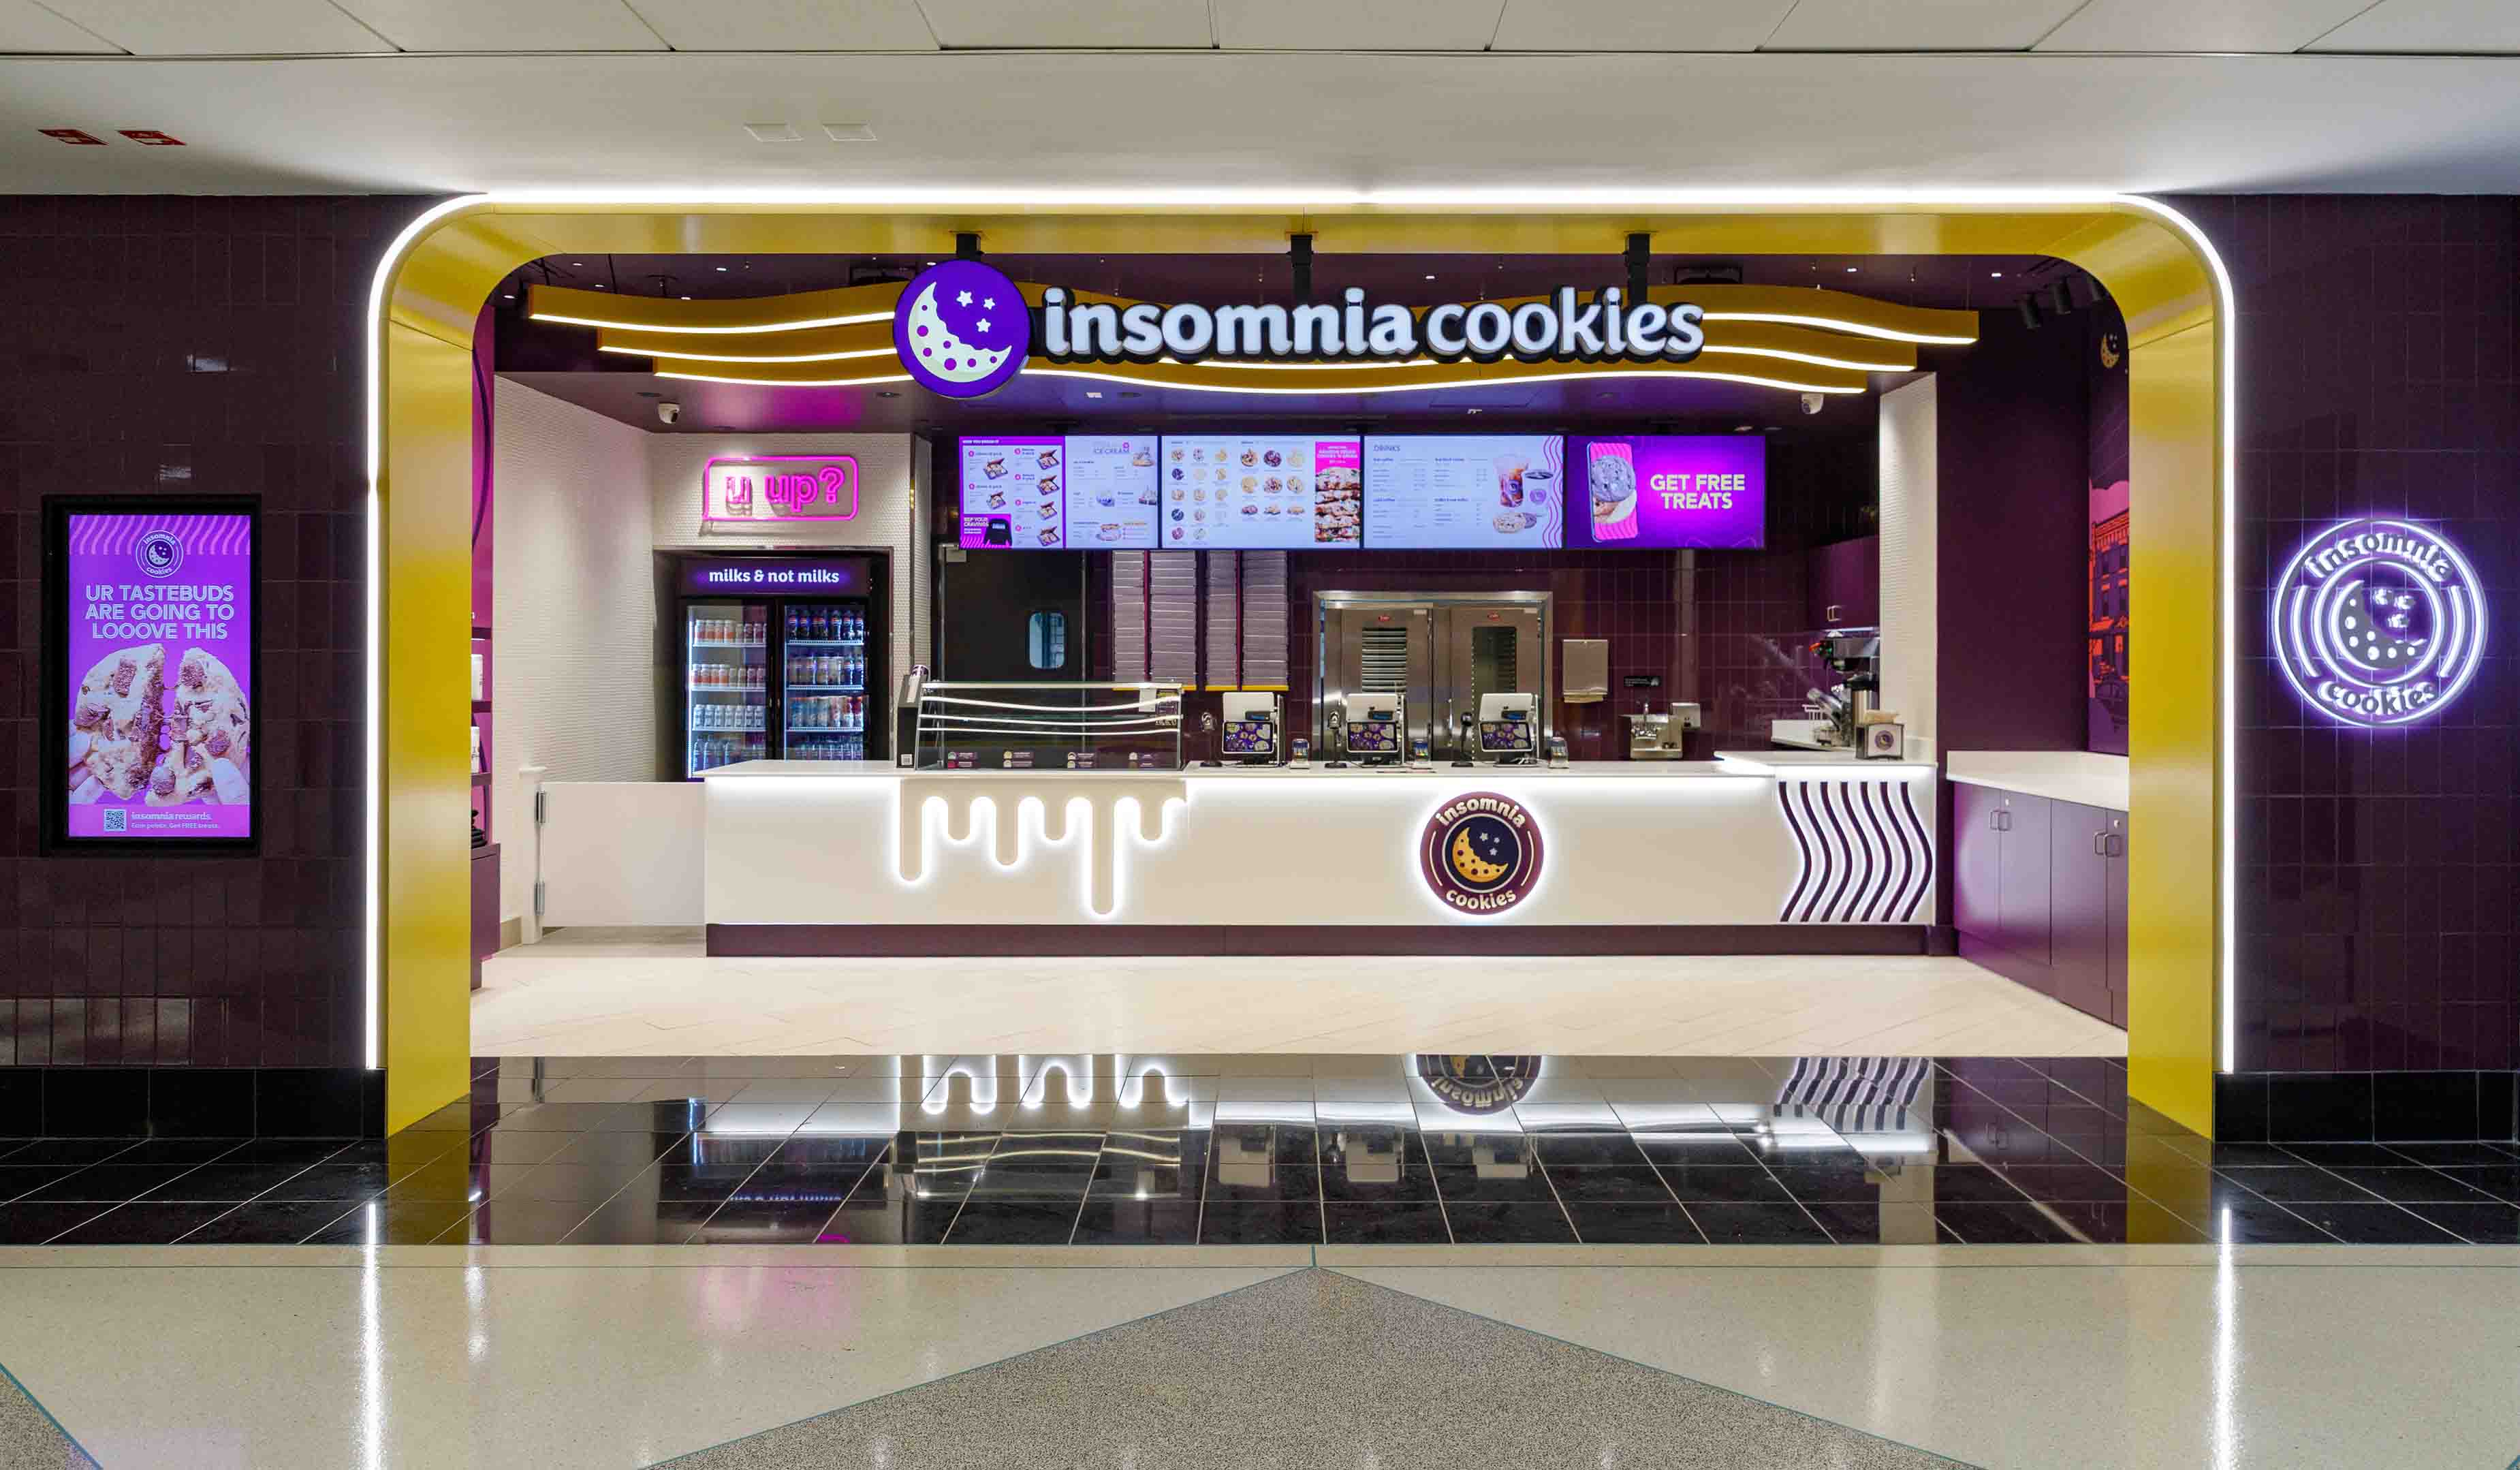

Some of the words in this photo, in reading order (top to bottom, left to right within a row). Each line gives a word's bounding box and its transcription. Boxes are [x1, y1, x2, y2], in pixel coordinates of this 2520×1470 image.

[1044, 287, 1418, 356] insomnia
[1427, 286, 1705, 356] cookies
[1373, 444, 1401, 452] DRINKS
[726, 475, 751, 503] u
[764, 465, 845, 512] up?
[1650, 474, 1690, 491] GET
[1696, 474, 1746, 491] FREE
[1661, 492, 1733, 510] TREATS
[142, 534, 175, 545] insomnia
[2304, 533, 2453, 582] insomnia
[709, 568, 751, 583] milks
[754, 569, 764, 582] &
[768, 570, 795, 582] not
[798, 568, 840, 584] milks
[86, 584, 113, 601] UR
[119, 584, 234, 601] TASTEBUDS
[86, 604, 125, 621] ARE
[131, 604, 201, 621] GOING
[206, 604, 234, 621] TO
[93, 623, 177, 640] LOOOVE
[183, 623, 228, 640] THIS
[2318, 681, 2436, 716] cookies
[1436, 798, 1526, 828] insomnia
[1446, 890, 1517, 909] cookies
